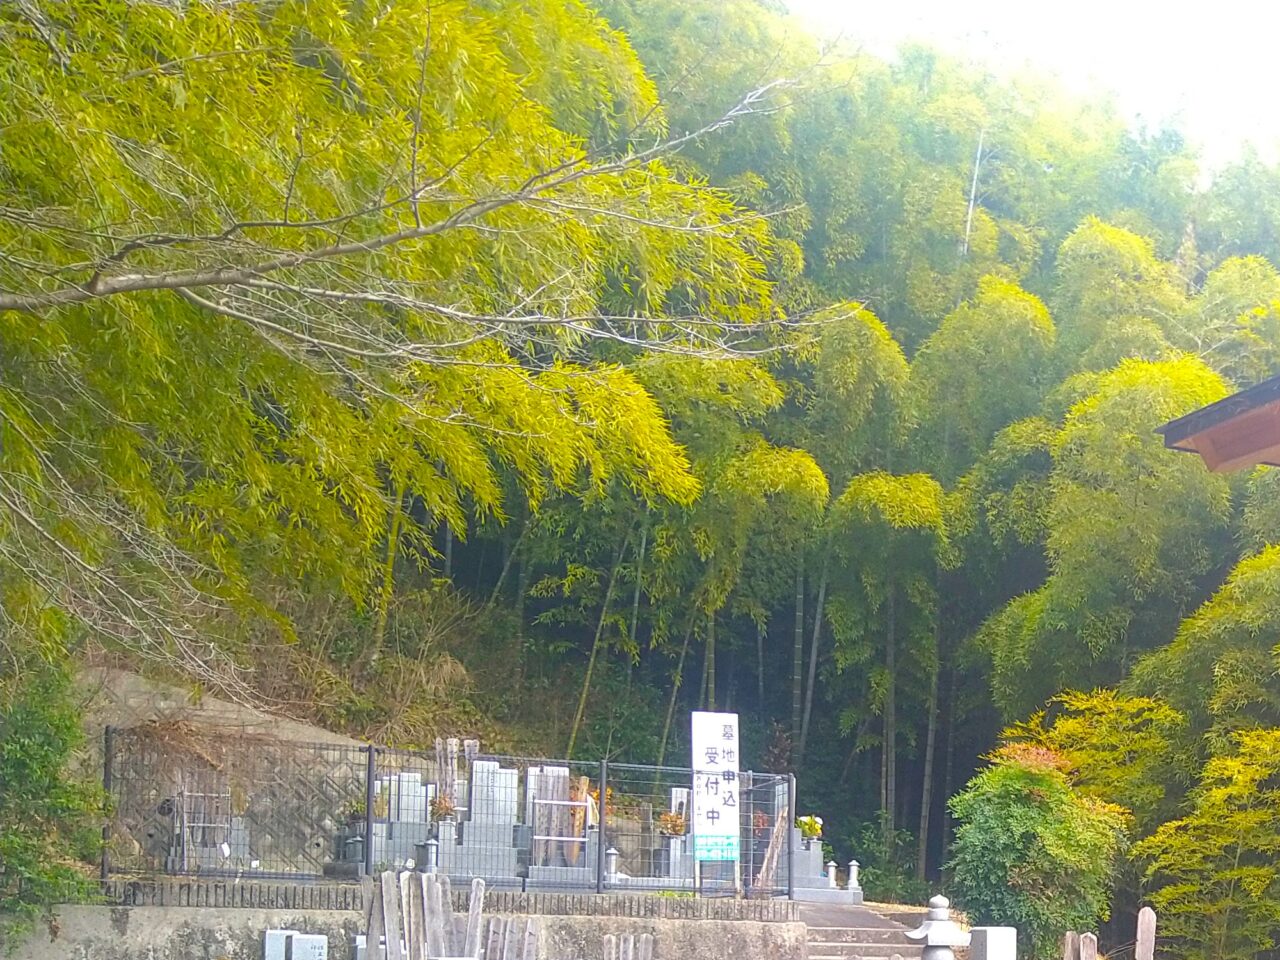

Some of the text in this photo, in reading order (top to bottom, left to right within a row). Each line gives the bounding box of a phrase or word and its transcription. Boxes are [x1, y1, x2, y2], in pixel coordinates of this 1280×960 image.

[704, 747, 721, 826] 受付中
[722, 724, 736, 808] 墓地申込
